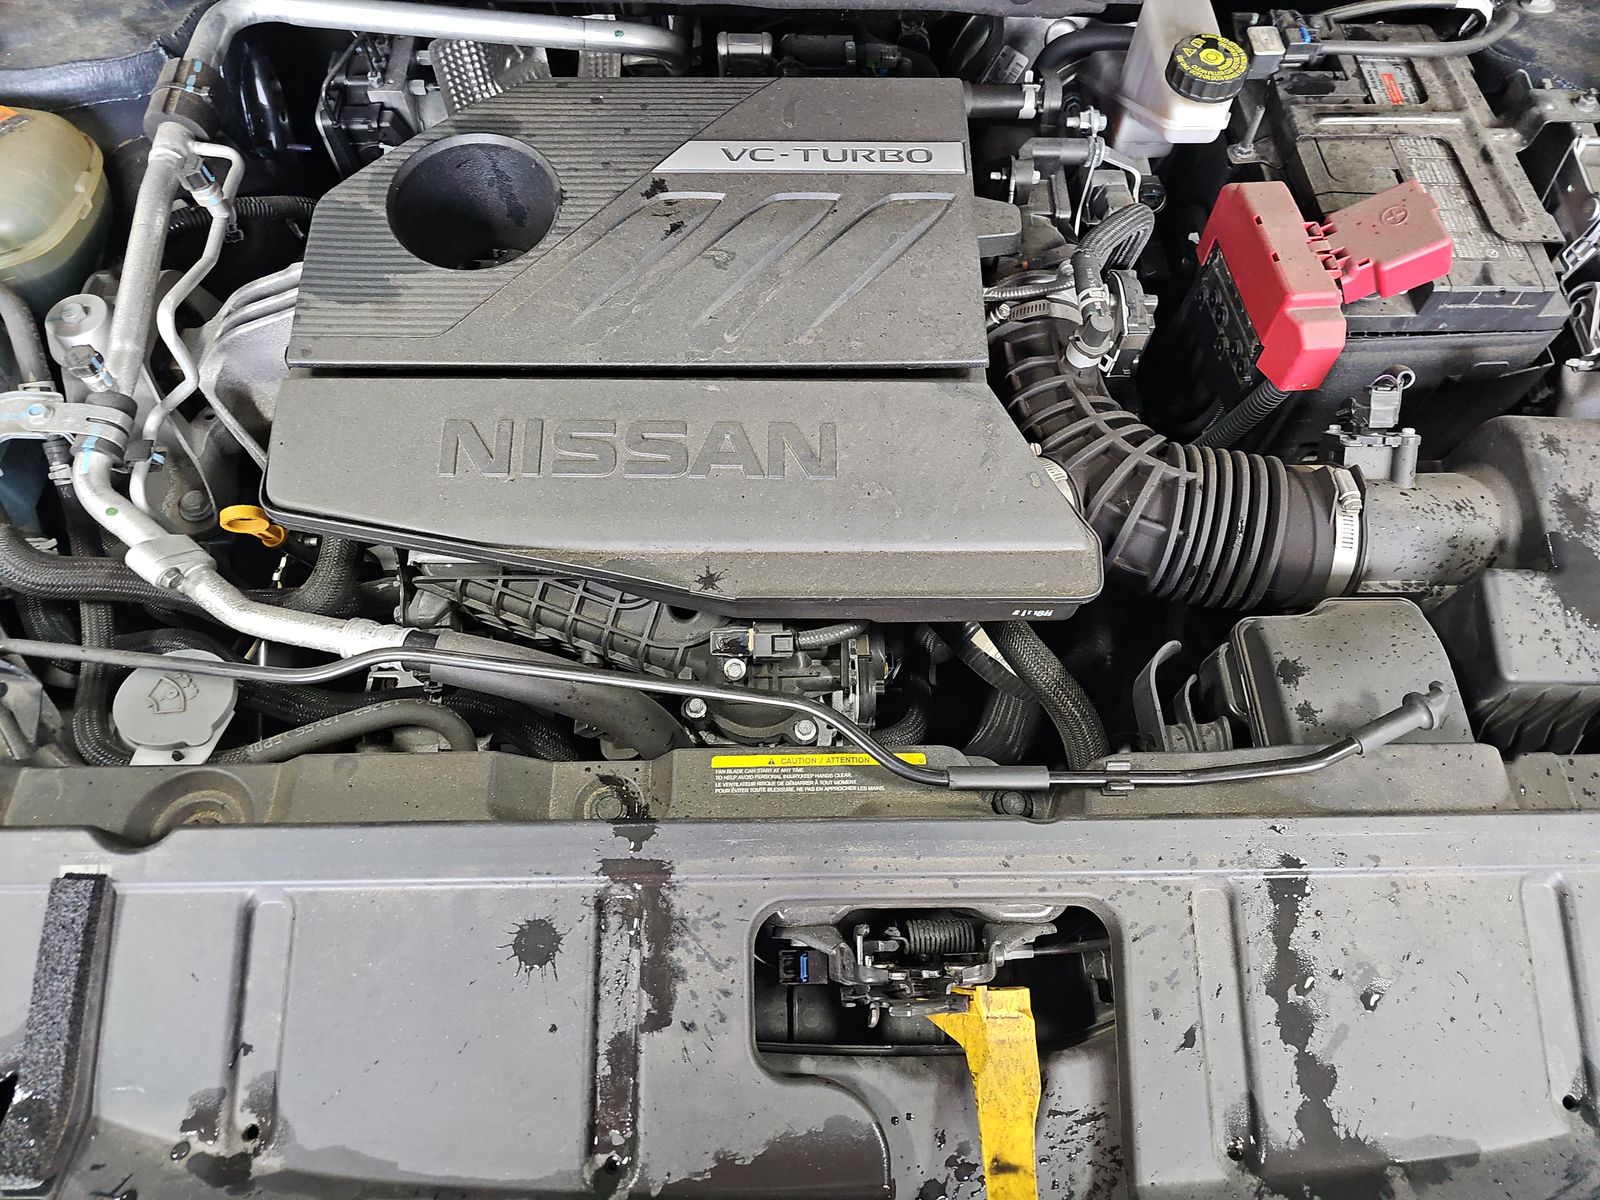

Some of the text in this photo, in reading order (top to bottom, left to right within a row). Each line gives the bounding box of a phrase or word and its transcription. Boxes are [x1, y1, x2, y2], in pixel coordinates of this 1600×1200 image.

[719, 147, 933, 163] VC-TURBO
[438, 418, 837, 480] NISSAN
[780, 757, 817, 765] CAUTION
[826, 756, 870, 764] ATTENTION
